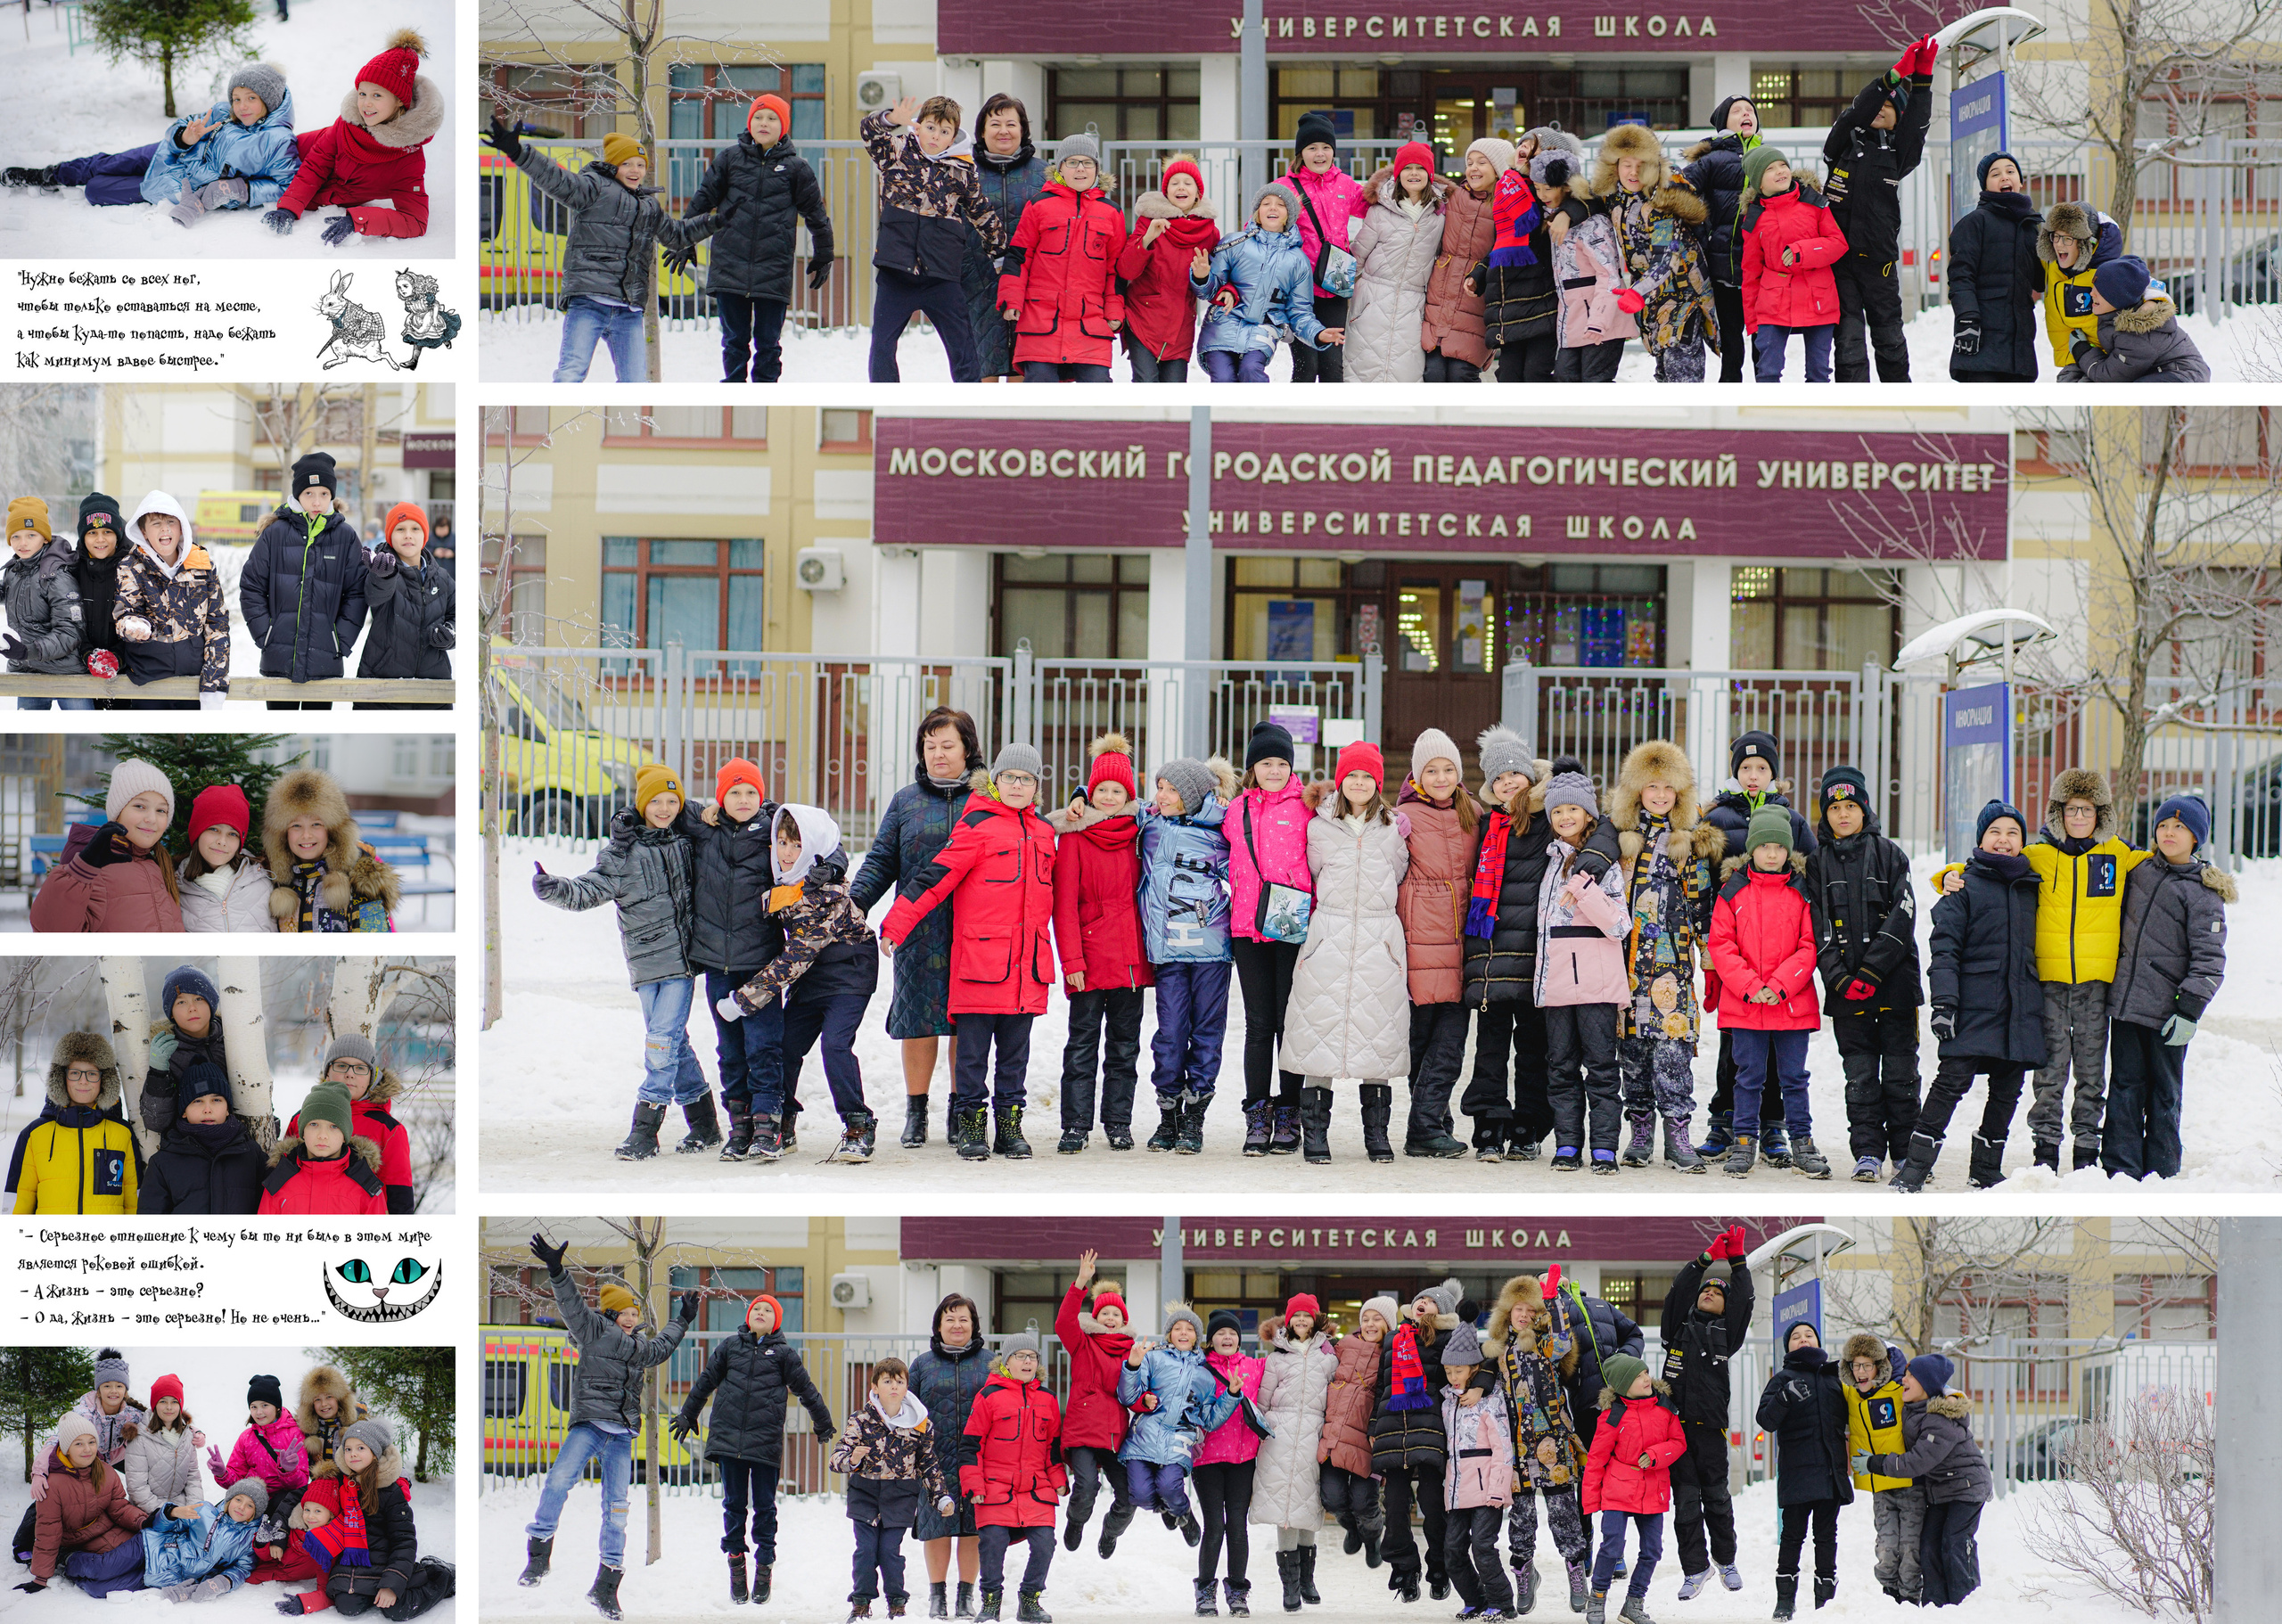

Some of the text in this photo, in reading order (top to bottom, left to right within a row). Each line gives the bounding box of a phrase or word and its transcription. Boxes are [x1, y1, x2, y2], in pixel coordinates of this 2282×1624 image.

[1594, 14, 1718, 37] ШКОЛА
[1958, 94, 1991, 123] ИНФОРМАЦИЯ
[406, 439, 456, 452] МОСКОВ
[889, 445, 1146, 478] МОСКОВСКИЙ
[1413, 453, 1737, 487] ПЕДАГОГИЧЕСКИЙ
[1757, 459, 1996, 491] УНИВЕРСИТЕТ
[1566, 514, 1697, 541] ШКОЛА
[1955, 705, 1993, 729] ИНФОРМАЦИЯ
[1465, 1228, 1572, 1248] ШКОЛА
[1779, 1299, 1809, 1324] ИНФОРМАЦИЯ
